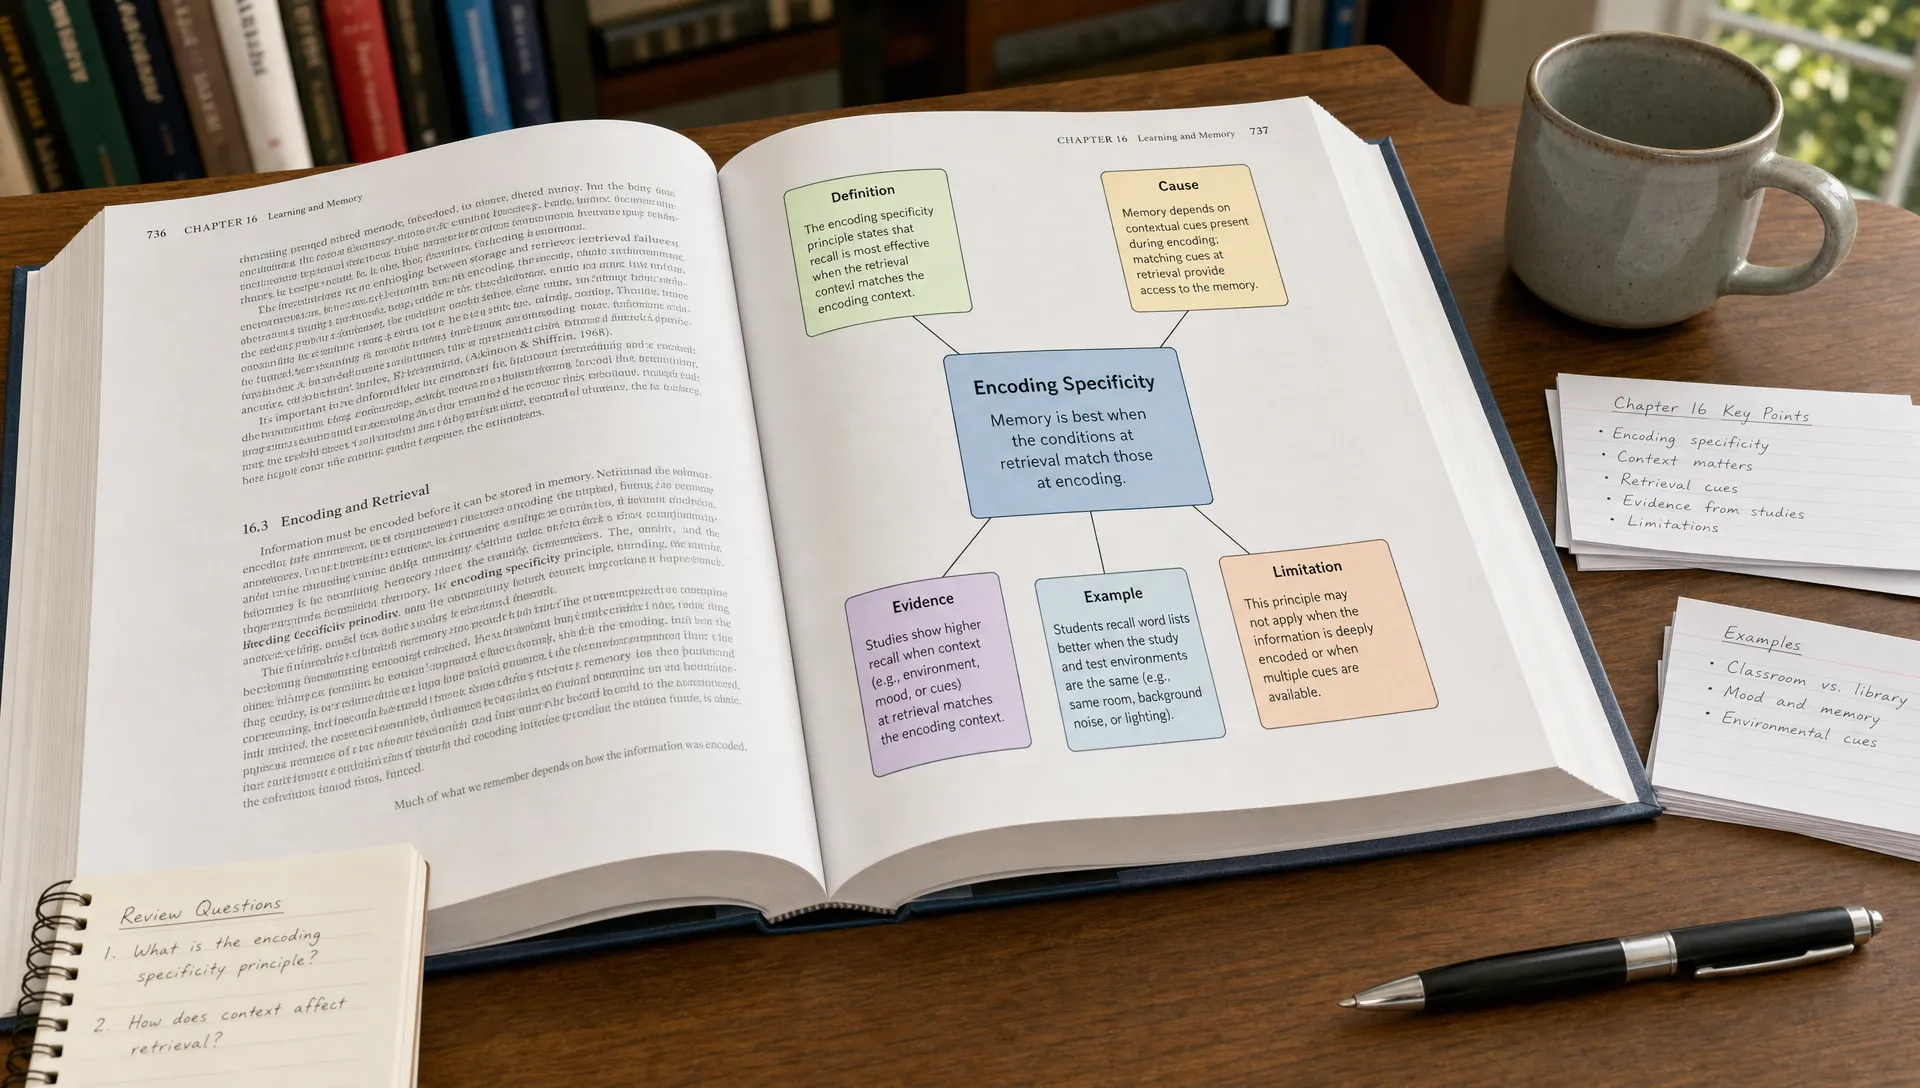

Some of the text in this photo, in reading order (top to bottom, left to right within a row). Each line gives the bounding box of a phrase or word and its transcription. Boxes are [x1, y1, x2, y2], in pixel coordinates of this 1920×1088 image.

[1057, 126, 1268, 144] CHAPTER 16 Learning and Memory 737
[831, 185, 895, 203] Definition
[1158, 180, 1199, 192] Cause
[147, 195, 362, 239] 736 CHAPTER 16 Learning and Memory
[804, 206, 934, 234] The encoding specificity
[1122, 203, 1231, 218] Memory depends on
[1125, 217, 1249, 233] contextual cues present
[807, 232, 854, 253] principle
[857, 228, 889, 240] states
[810, 239, 930, 266] recall is most effective
[1129, 238, 1164, 250] during
[812, 255, 909, 282] when the retrieval
[1133, 250, 1224, 265] matching cues at
[858, 274, 904, 288] matches
[906, 271, 924, 281] the
[1136, 265, 1225, 280] retrieval provide
[818, 288, 915, 314] encoding context.
[1140, 282, 1258, 295] access to the memory.
[973, 374, 1155, 396] Encoding Specificity
[990, 408, 1147, 428] Memory is best when
[1614, 396, 1809, 425] Chapter 16 Key Points
[1011, 429, 1134, 447] the conditions at
[1613, 426, 1769, 456] Encoding specificity
[1000, 449, 1153, 470] retrieval match those
[1617, 450, 1752, 471] Context matters
[1037, 472, 1126, 489] at encoding.
[1620, 472, 1738, 494] Retrieval cues
[243, 483, 430, 534] 16.3 Encoding and Retrieval
[260, 473, 594, 556] Information must be encoded before it can be stored in memory.
[1623, 494, 1804, 520] Evidence from studies
[1627, 515, 1718, 533] Limitations
[450, 545, 614, 587] encoding specificity principle,
[1272, 561, 1343, 578] Limitation
[892, 595, 954, 614] Evidence
[1084, 587, 1143, 604] Example
[865, 620, 981, 651] Studies show higher
[1724, 625, 1801, 653] Examples
[869, 638, 981, 670] recall when context
[872, 657, 980, 690] (e.g., environment,
[1727, 660, 1908, 710] Classroom vs. library
[875, 677, 962, 708] mood, or cues)
[878, 694, 993, 727] at retrieval matches
[1723, 685, 1881, 729] Mood and memory
[881, 712, 1005, 745] the encoding context.
[1722, 711, 1877, 748] Environmental cues
[394, 741, 748, 811] Much of what we remember depends on how the information was encoded.
[120, 898, 281, 925] Review Questions
[104, 928, 321, 960] 1. What is the encoding
[137, 949, 318, 987] specificity principle?
[94, 996, 347, 1033] 2. How does context affect
[131, 1031, 223, 1055] retrieval?
